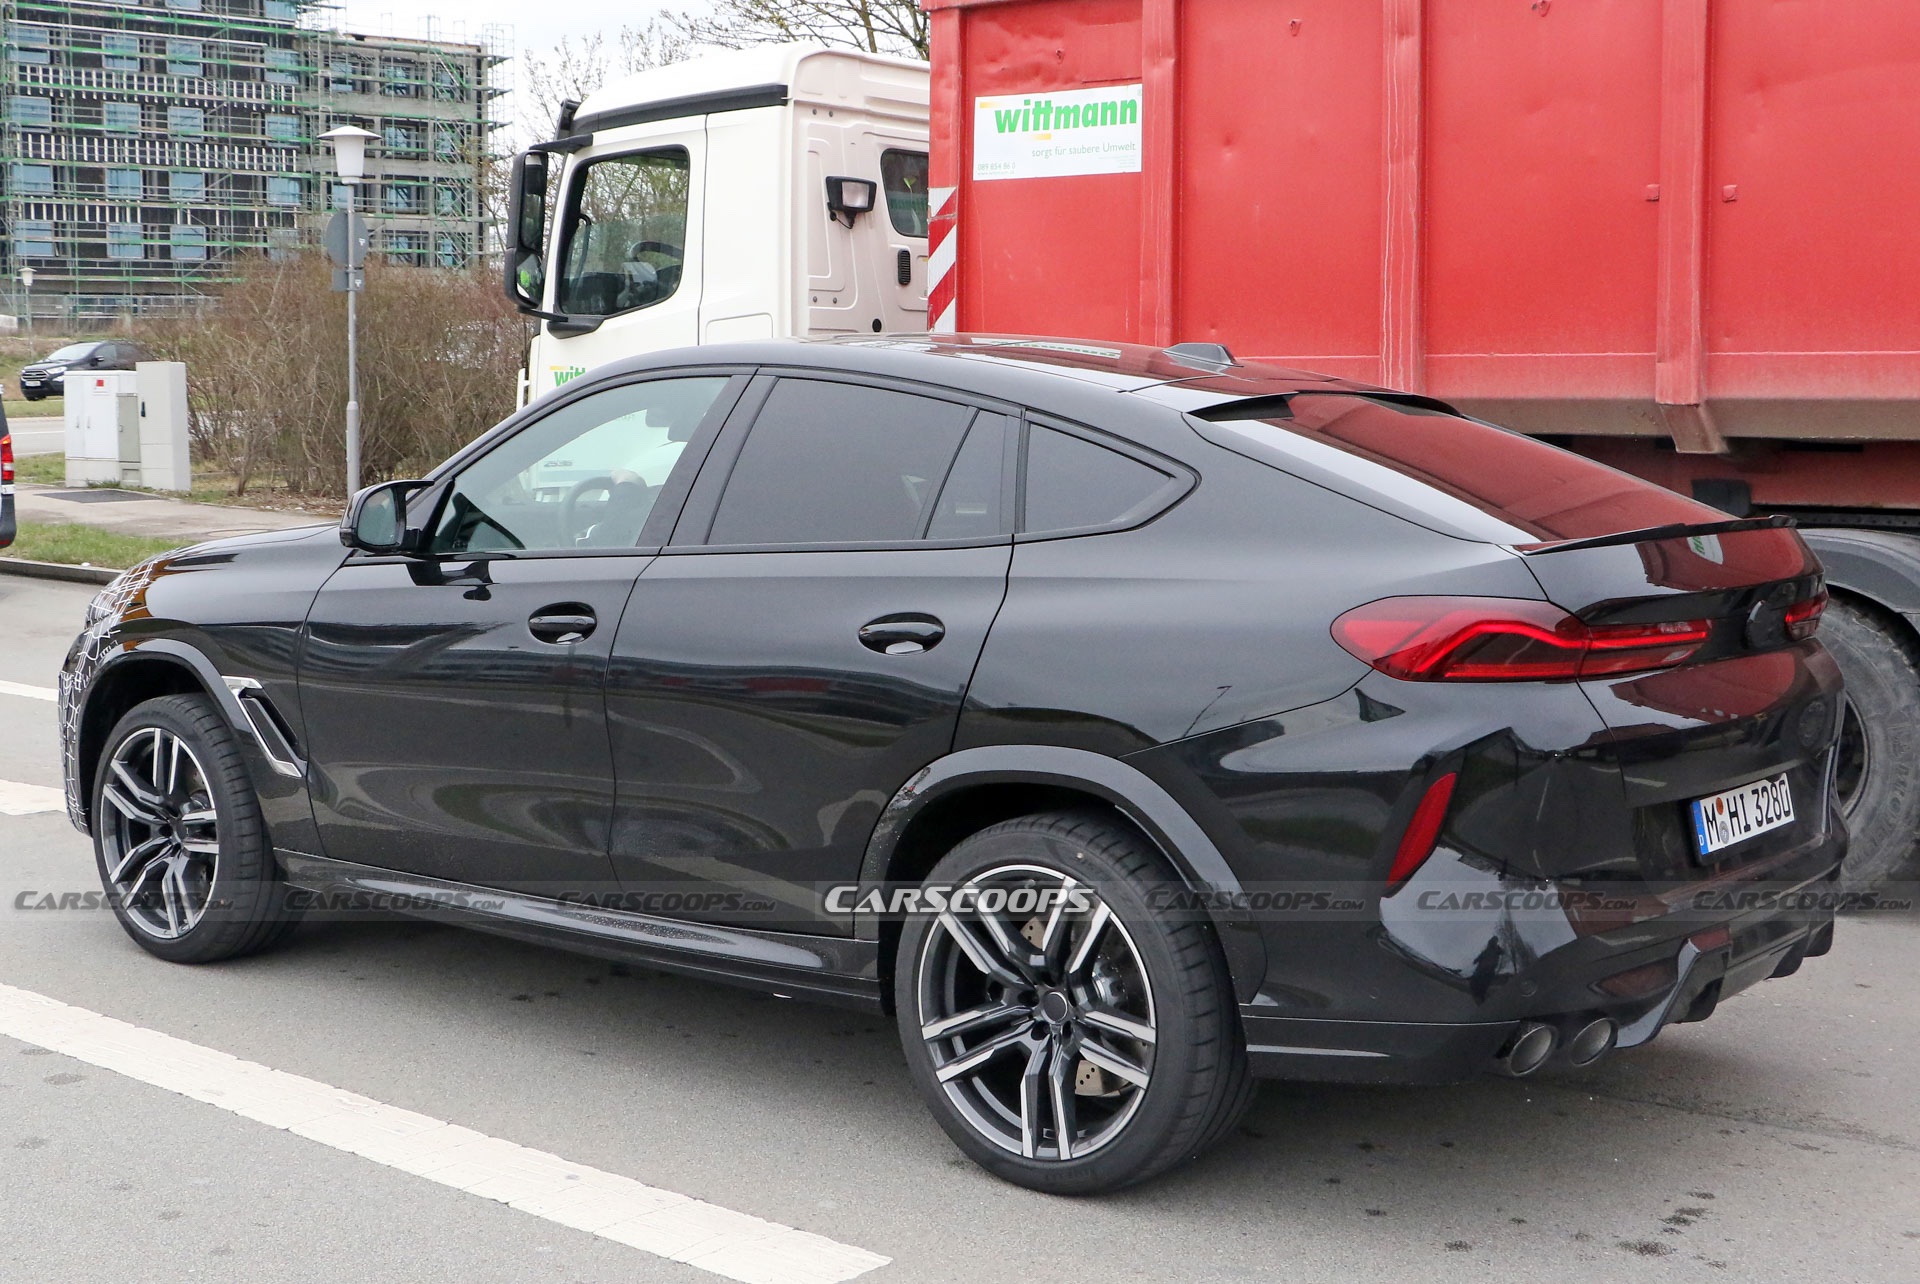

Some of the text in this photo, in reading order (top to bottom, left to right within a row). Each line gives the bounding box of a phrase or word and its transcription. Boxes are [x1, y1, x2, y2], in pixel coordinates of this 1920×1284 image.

[995, 98, 1137, 133] wittmann
[1031, 149, 1053, 159] sorgt
[1069, 144, 1100, 155] saubere
[1103, 141, 1136, 152] Umwelt
[1704, 779, 1791, 845] M HI 3280
